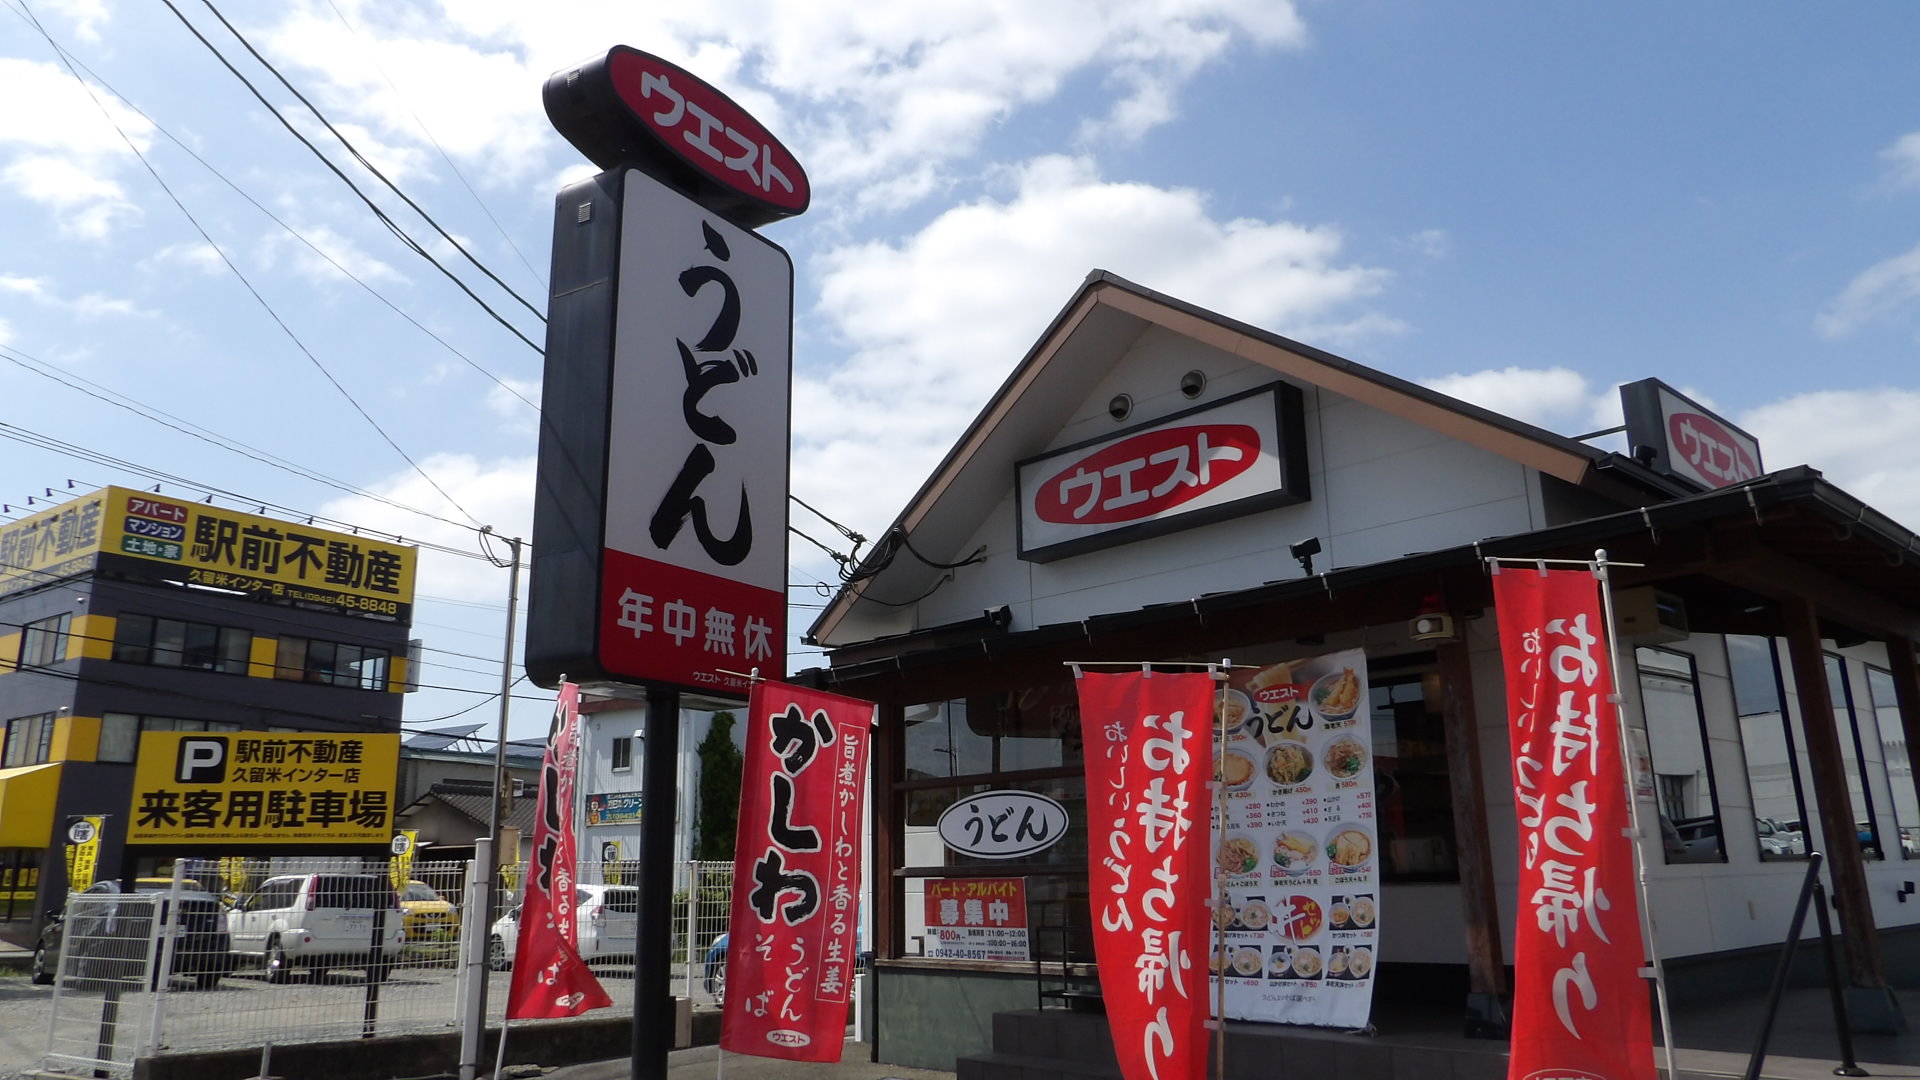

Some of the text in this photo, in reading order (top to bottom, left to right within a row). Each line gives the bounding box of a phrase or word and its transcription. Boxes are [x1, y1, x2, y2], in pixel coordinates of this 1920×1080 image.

[641, 71, 794, 193] ウエスト
[648, 219, 758, 566] うどん
[1680, 418, 1754, 482] ウエスト
[1058, 431, 1243, 520] ウエスト
[128, 518, 182, 539] マンション
[131, 499, 184, 520] アパート
[191, 515, 403, 596] 駅前不動産
[188, 569, 284, 596] 久留米インター店
[617, 586, 773, 662] 年中無休
[693, 671, 721, 684] ウエスト
[1259, 686, 1299, 701] ウエスト
[1247, 705, 1314, 739] うどん
[182, 741, 223, 780] P
[234, 739, 363, 764] 駅前不動産
[232, 767, 361, 783] 久留米インター店
[136, 789, 388, 829] 来客用駐車場
[749, 702, 836, 926] かしわ
[963, 803, 1049, 846] うどん
[819, 733, 858, 995] 旨煮かしわと香る生姜
[932, 882, 1017, 897] パート・アルバイト
[940, 898, 1009, 927] 募集中
[745, 932, 778, 1018] そば
[780, 936, 808, 1022] うどん
[771, 1031, 806, 1045] ウエスト
